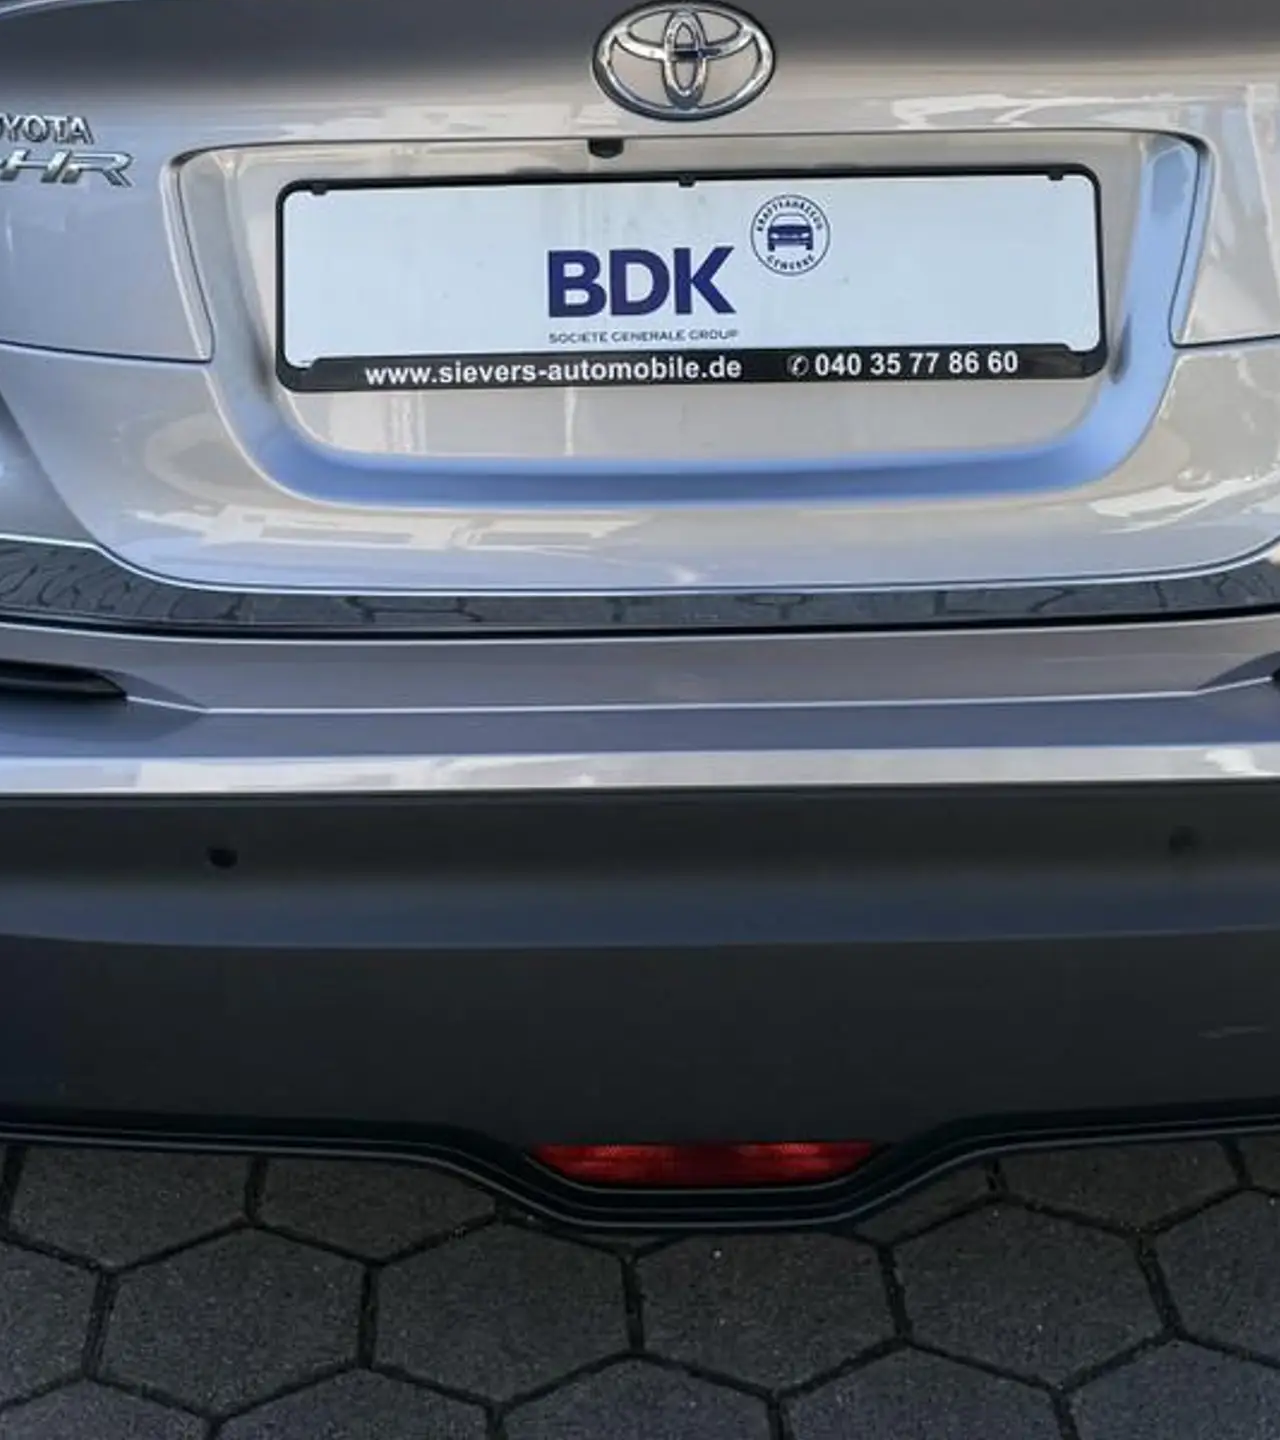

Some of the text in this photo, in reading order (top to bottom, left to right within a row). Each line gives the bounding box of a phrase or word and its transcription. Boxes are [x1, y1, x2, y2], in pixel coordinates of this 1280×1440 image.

[548, 246, 736, 318] BDK
[688, 328, 738, 341] GROUP
[365, 350, 1018, 385] www.sievers-automobile.de 040 35 77 86 60
